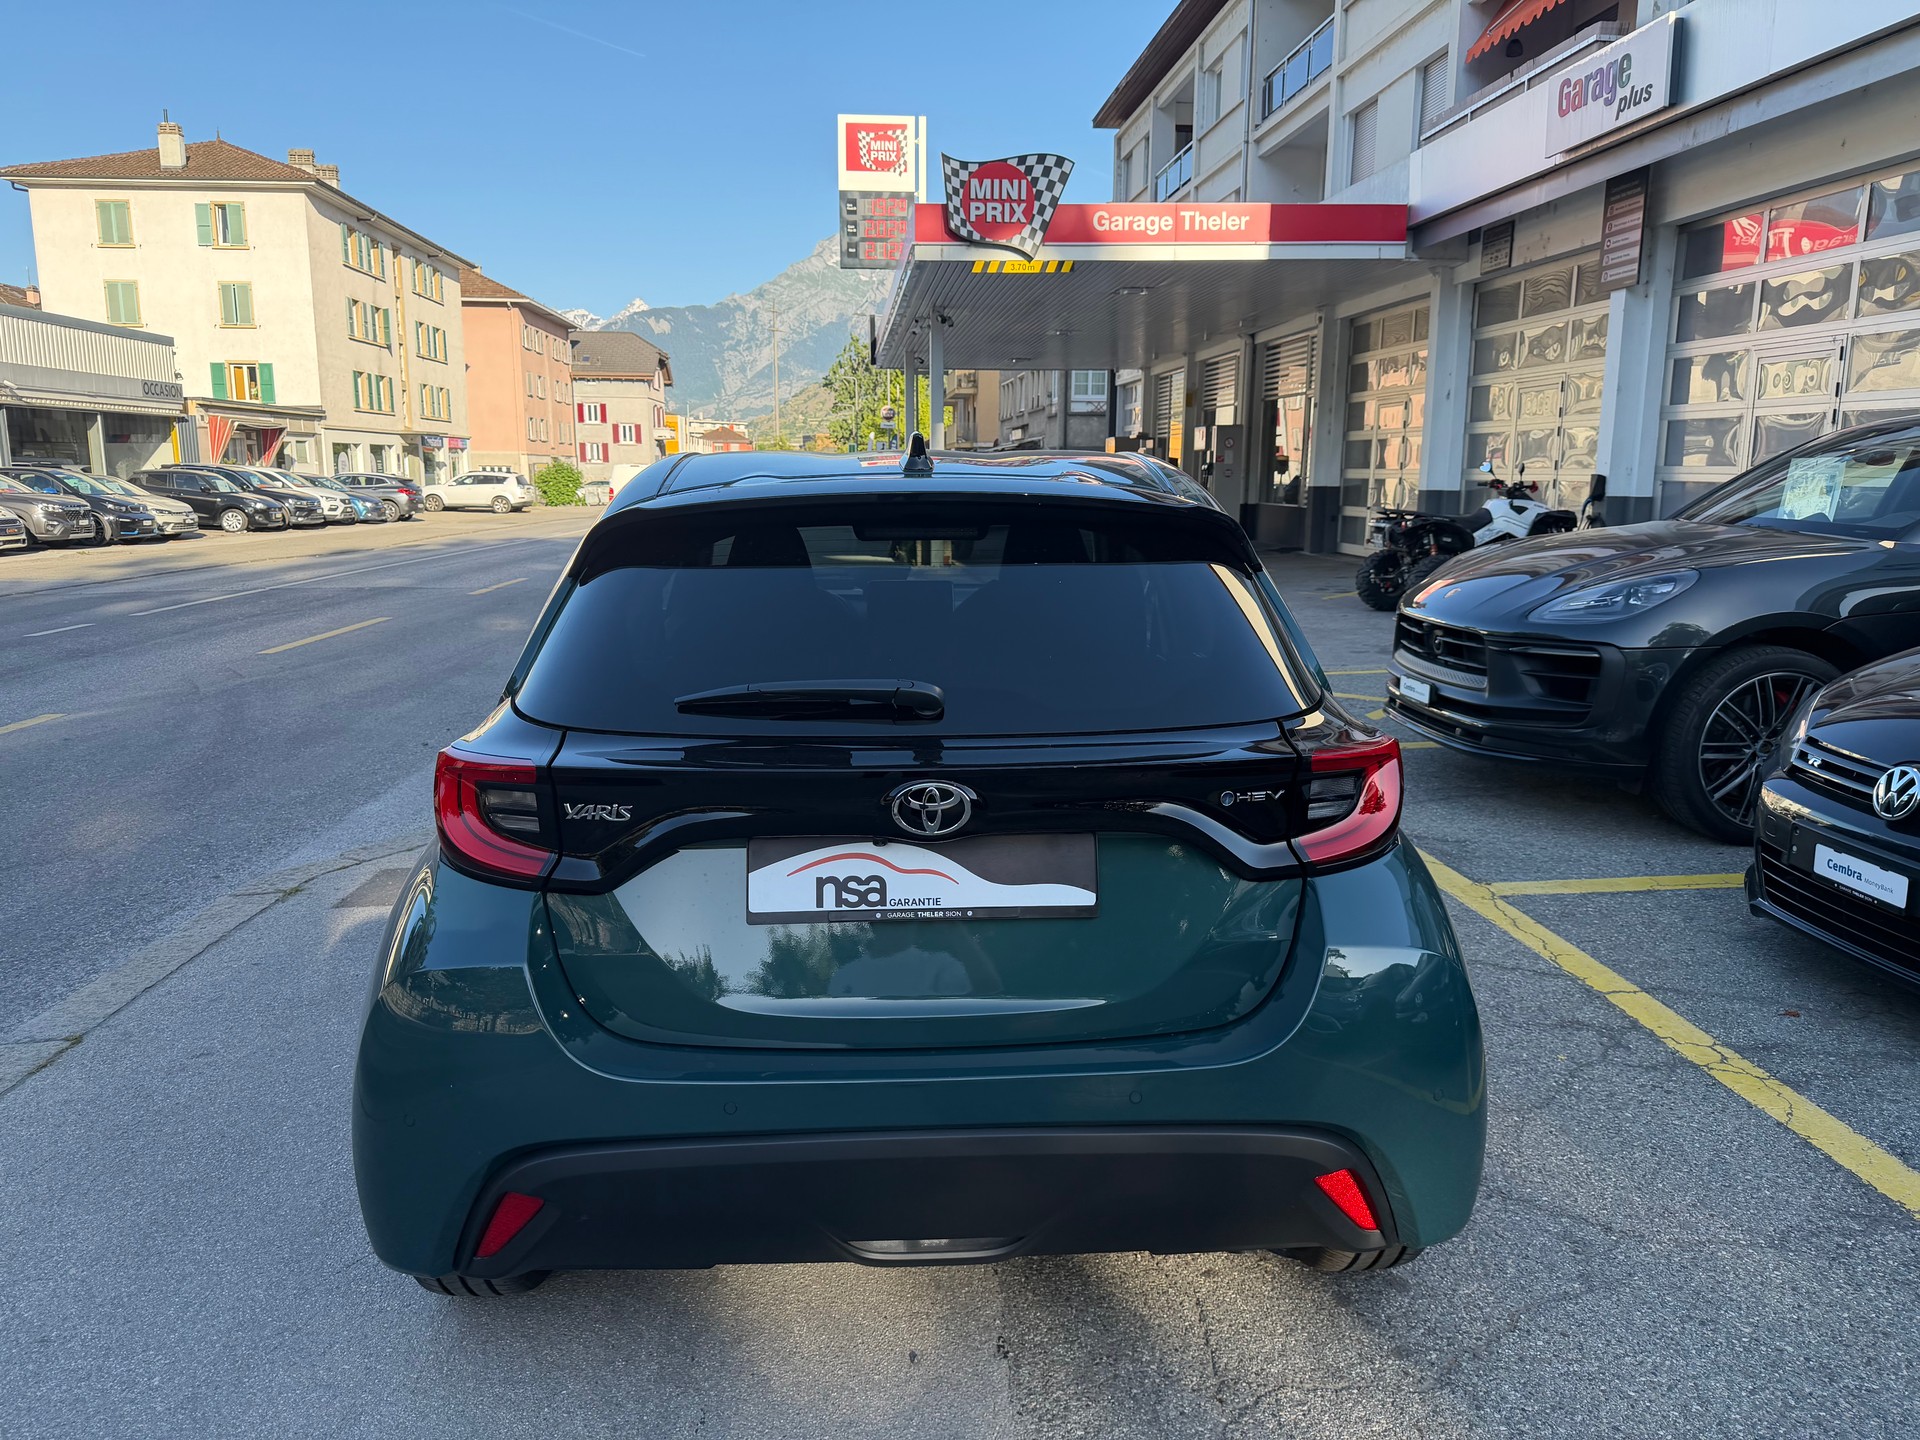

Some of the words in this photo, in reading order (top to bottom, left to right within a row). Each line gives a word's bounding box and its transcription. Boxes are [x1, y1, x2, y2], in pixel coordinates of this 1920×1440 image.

[1558, 53, 1632, 118] Garage
[1615, 83, 1653, 121] plus
[870, 140, 897, 151] MINI
[870, 151, 897, 162] PRIX
[969, 178, 1027, 201] MINI
[969, 202, 1027, 224] PRIX
[1092, 211, 1173, 236] Garage
[1180, 211, 1250, 231] Theler
[143, 382, 184, 398] OCCASION
[1826, 858, 1863, 882] Cembra
[1863, 877, 1894, 894] MoneyBank
[815, 875, 887, 908] nsa
[889, 897, 942, 907] GARANTIE
